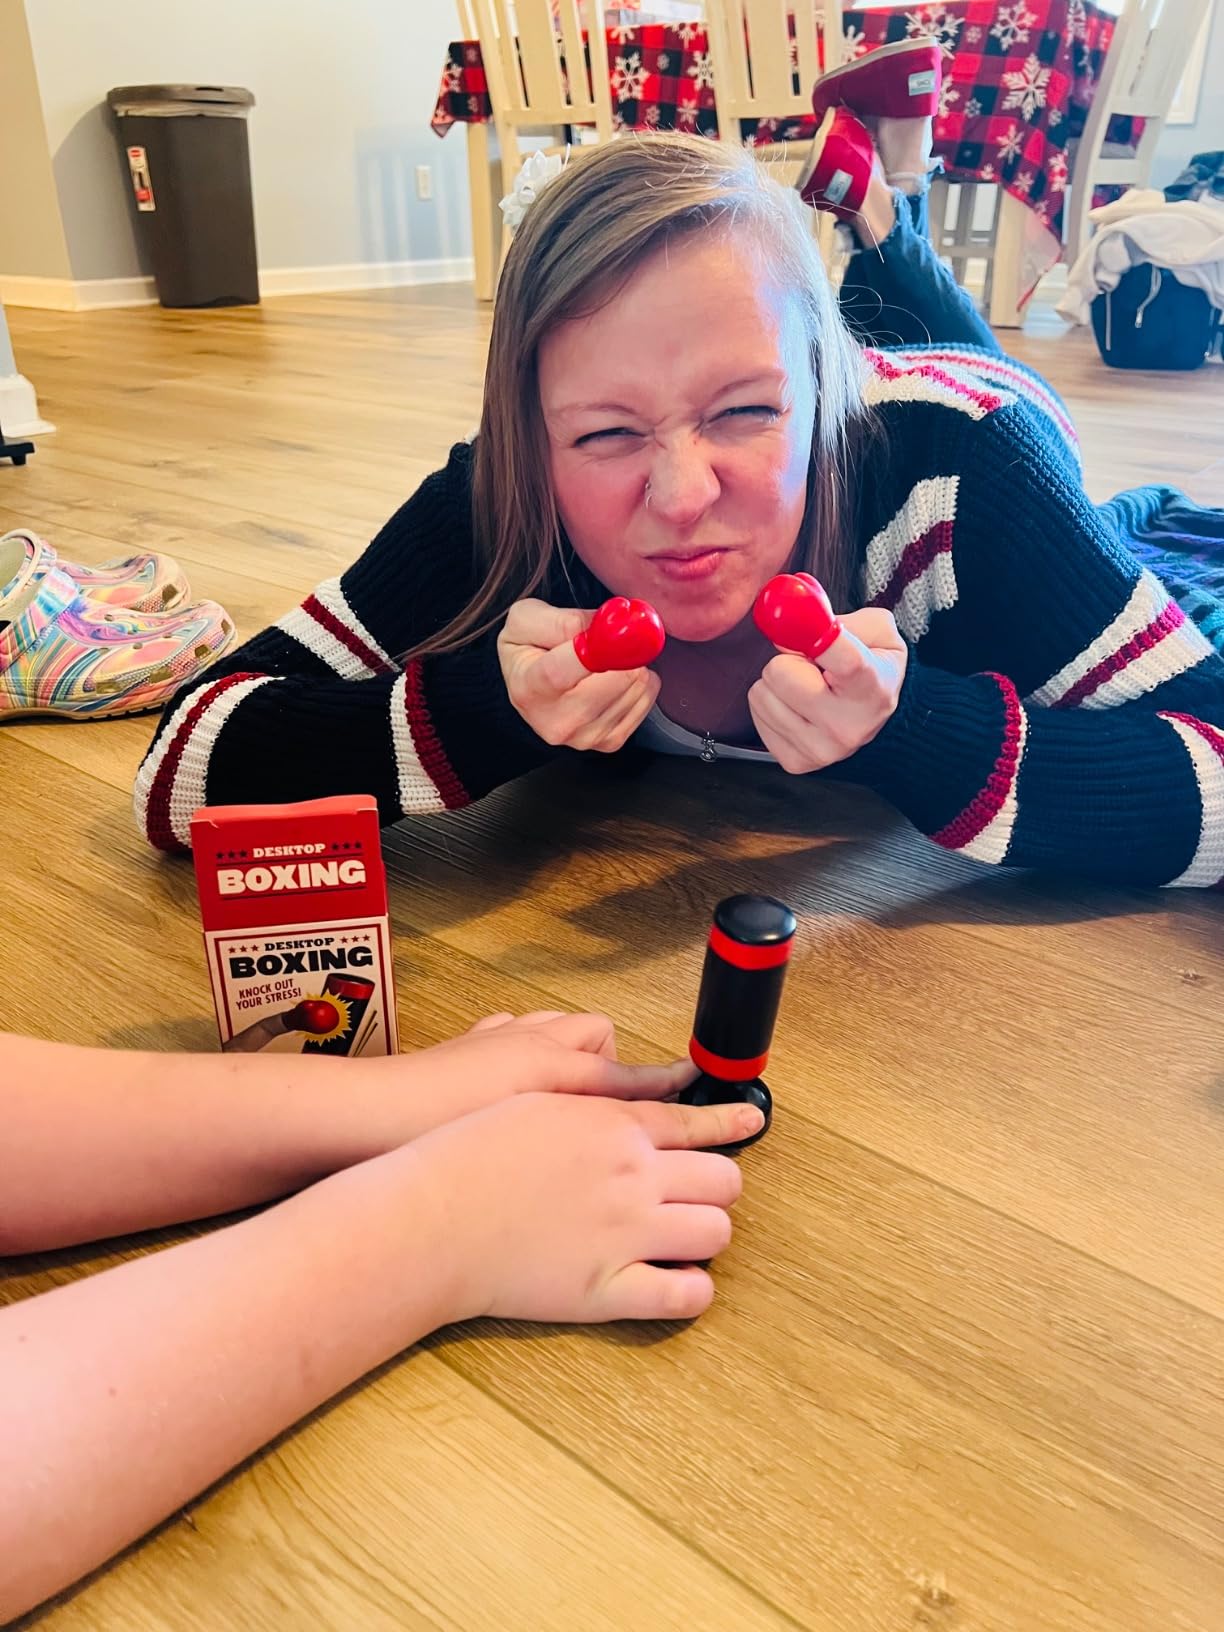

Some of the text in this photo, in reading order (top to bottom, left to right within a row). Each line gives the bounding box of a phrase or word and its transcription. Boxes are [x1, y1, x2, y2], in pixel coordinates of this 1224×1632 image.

[253, 843, 326, 858] DESKTOP
[216, 860, 367, 895] BOXING
[264, 937, 335, 952] DESKTOP
[229, 946, 373, 979] BOXING
[235, 988, 302, 1010] YOUR STRESS!
[238, 979, 294, 999] KNOCK OUT
